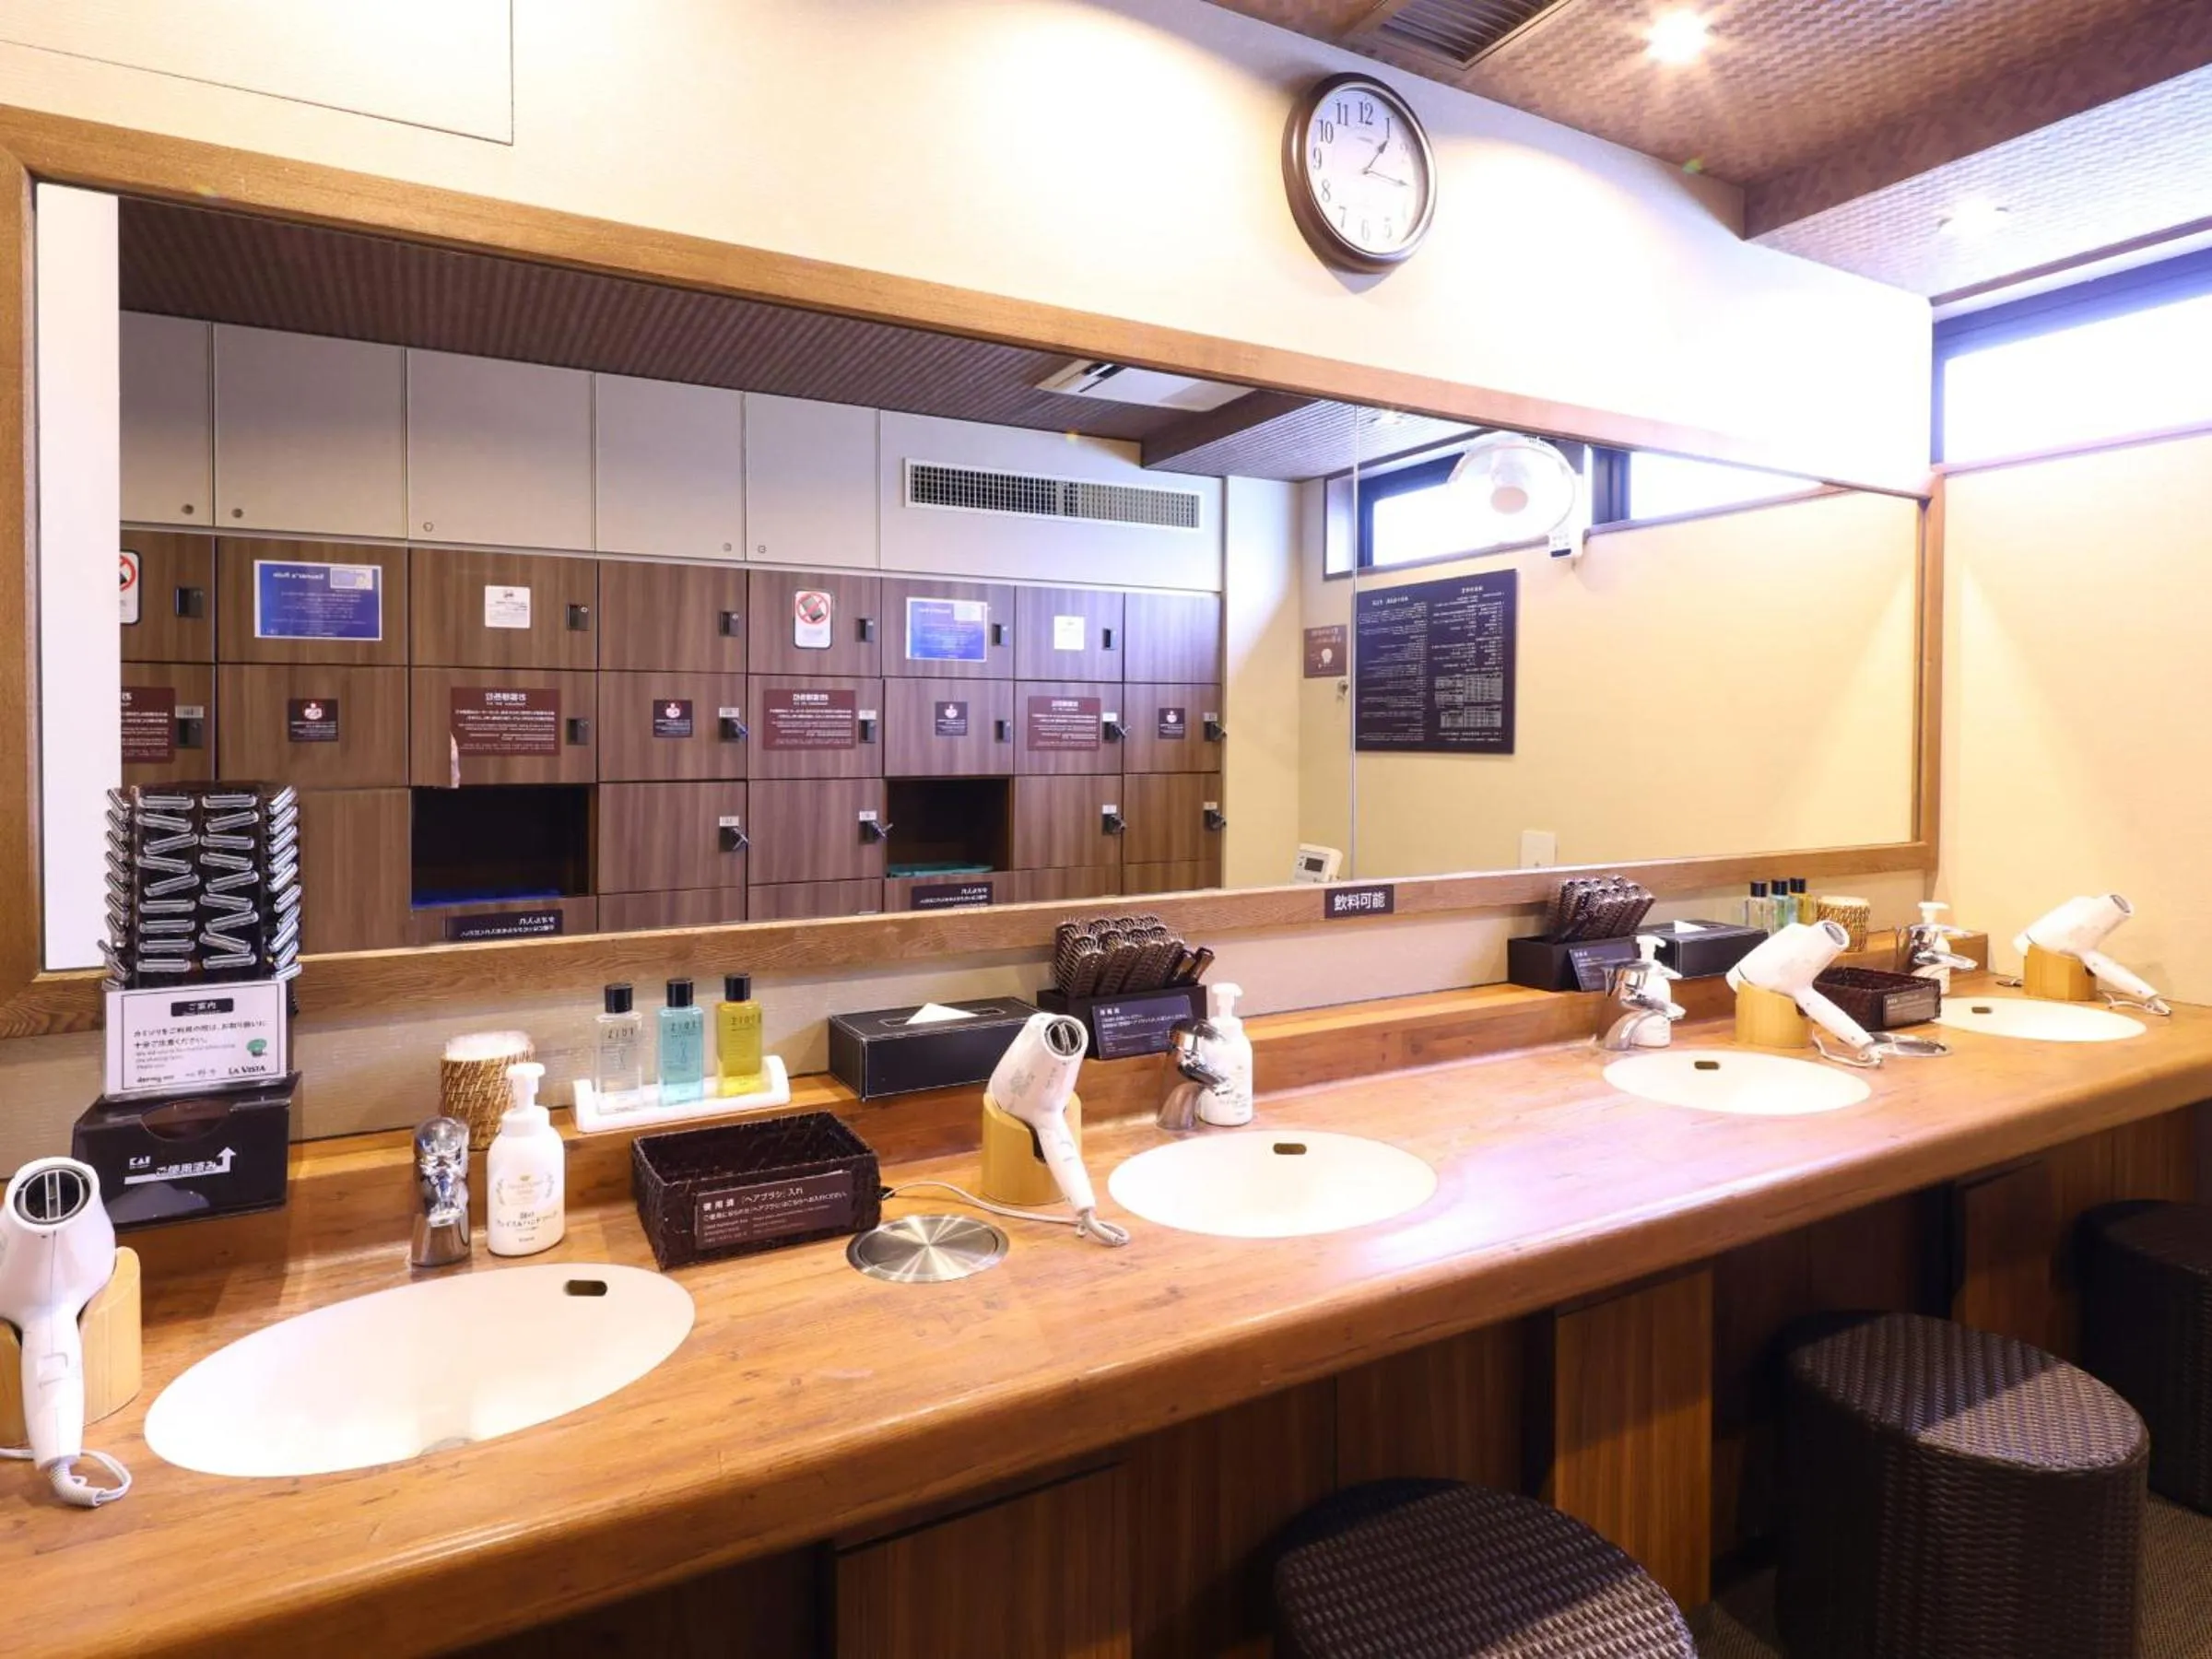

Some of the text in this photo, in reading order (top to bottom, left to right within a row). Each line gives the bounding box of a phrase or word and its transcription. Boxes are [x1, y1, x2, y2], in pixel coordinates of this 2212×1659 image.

[1336, 102, 1349, 126] 11
[1359, 100, 1373, 125] 12
[1318, 119, 1334, 144] 10
[1312, 147, 1323, 171] 9
[1321, 180, 1331, 203] 8
[1339, 206, 1347, 229] 7
[1334, 891, 1386, 912] 飲料可能
[129, 1155, 150, 1166] KAI
